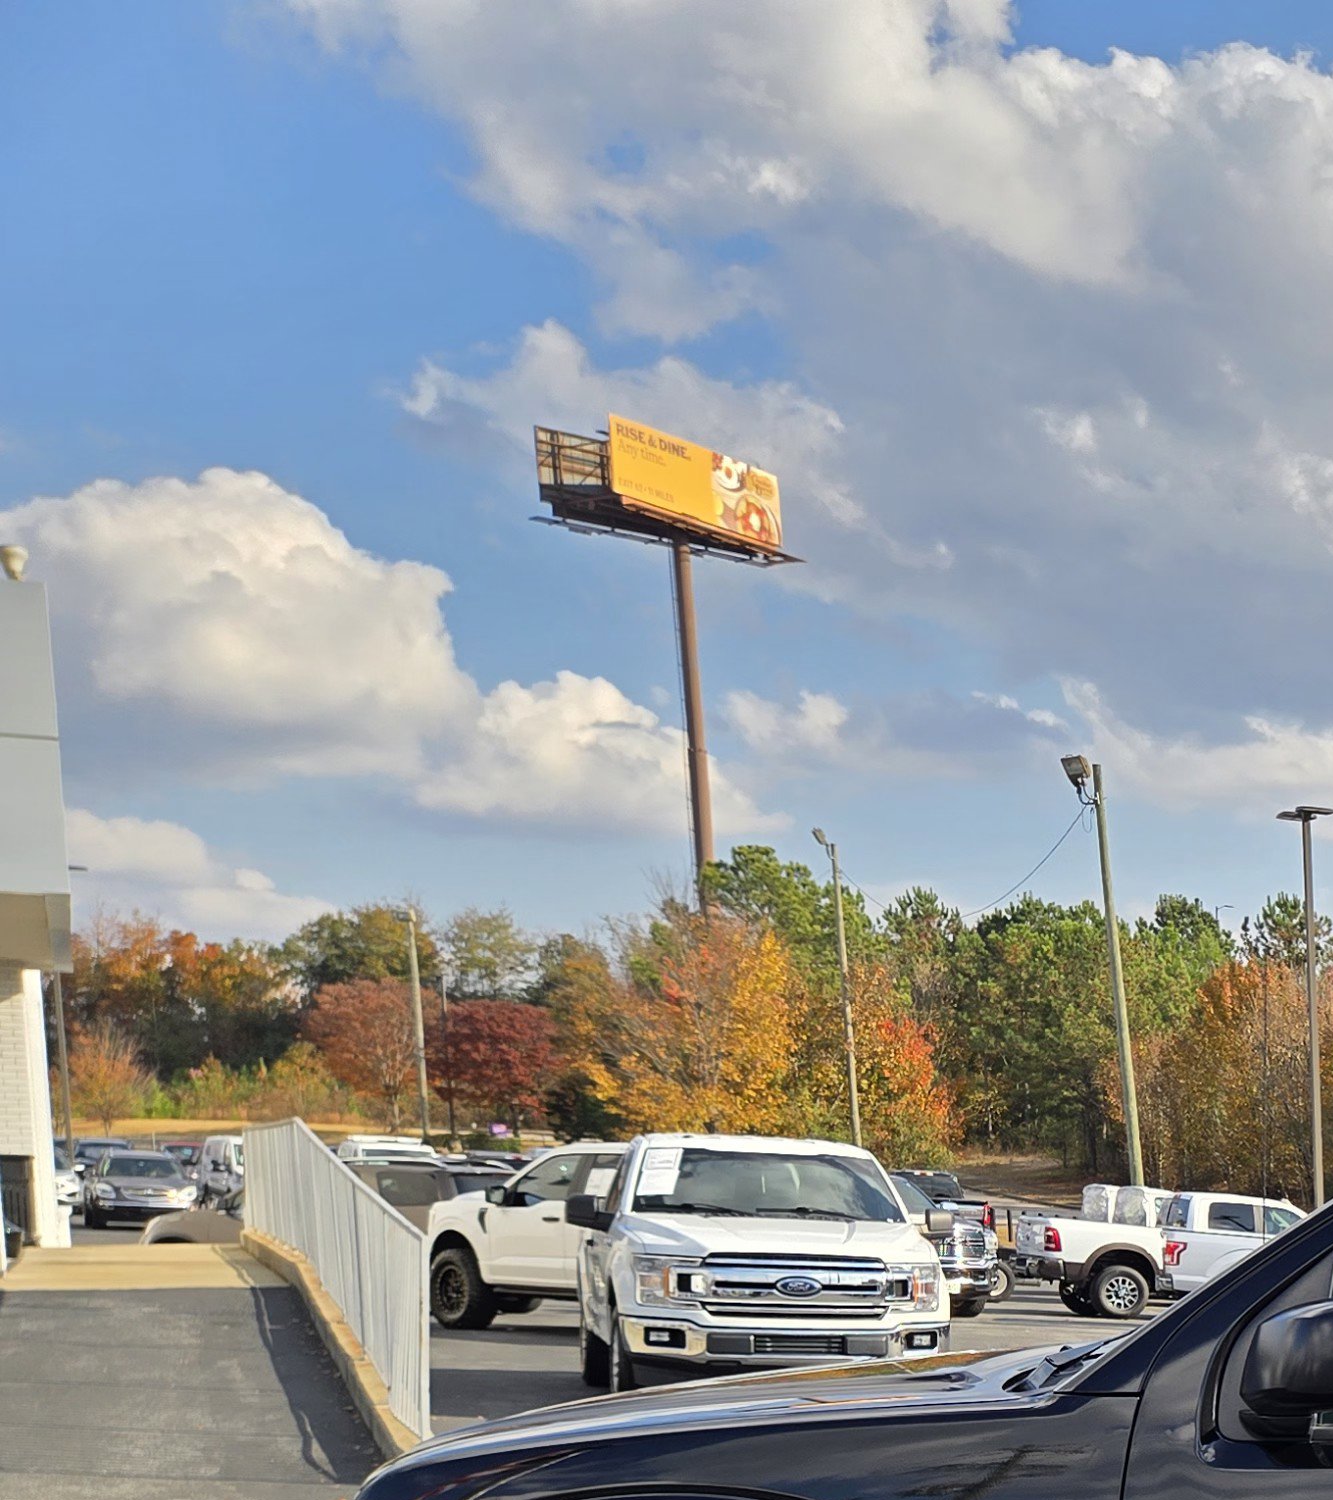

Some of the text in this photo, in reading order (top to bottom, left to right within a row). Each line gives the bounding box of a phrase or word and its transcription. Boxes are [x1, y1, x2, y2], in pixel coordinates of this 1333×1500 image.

[616, 423, 646, 445] RISE
[648, 434, 658, 449] &
[618, 439, 637, 460] Any
